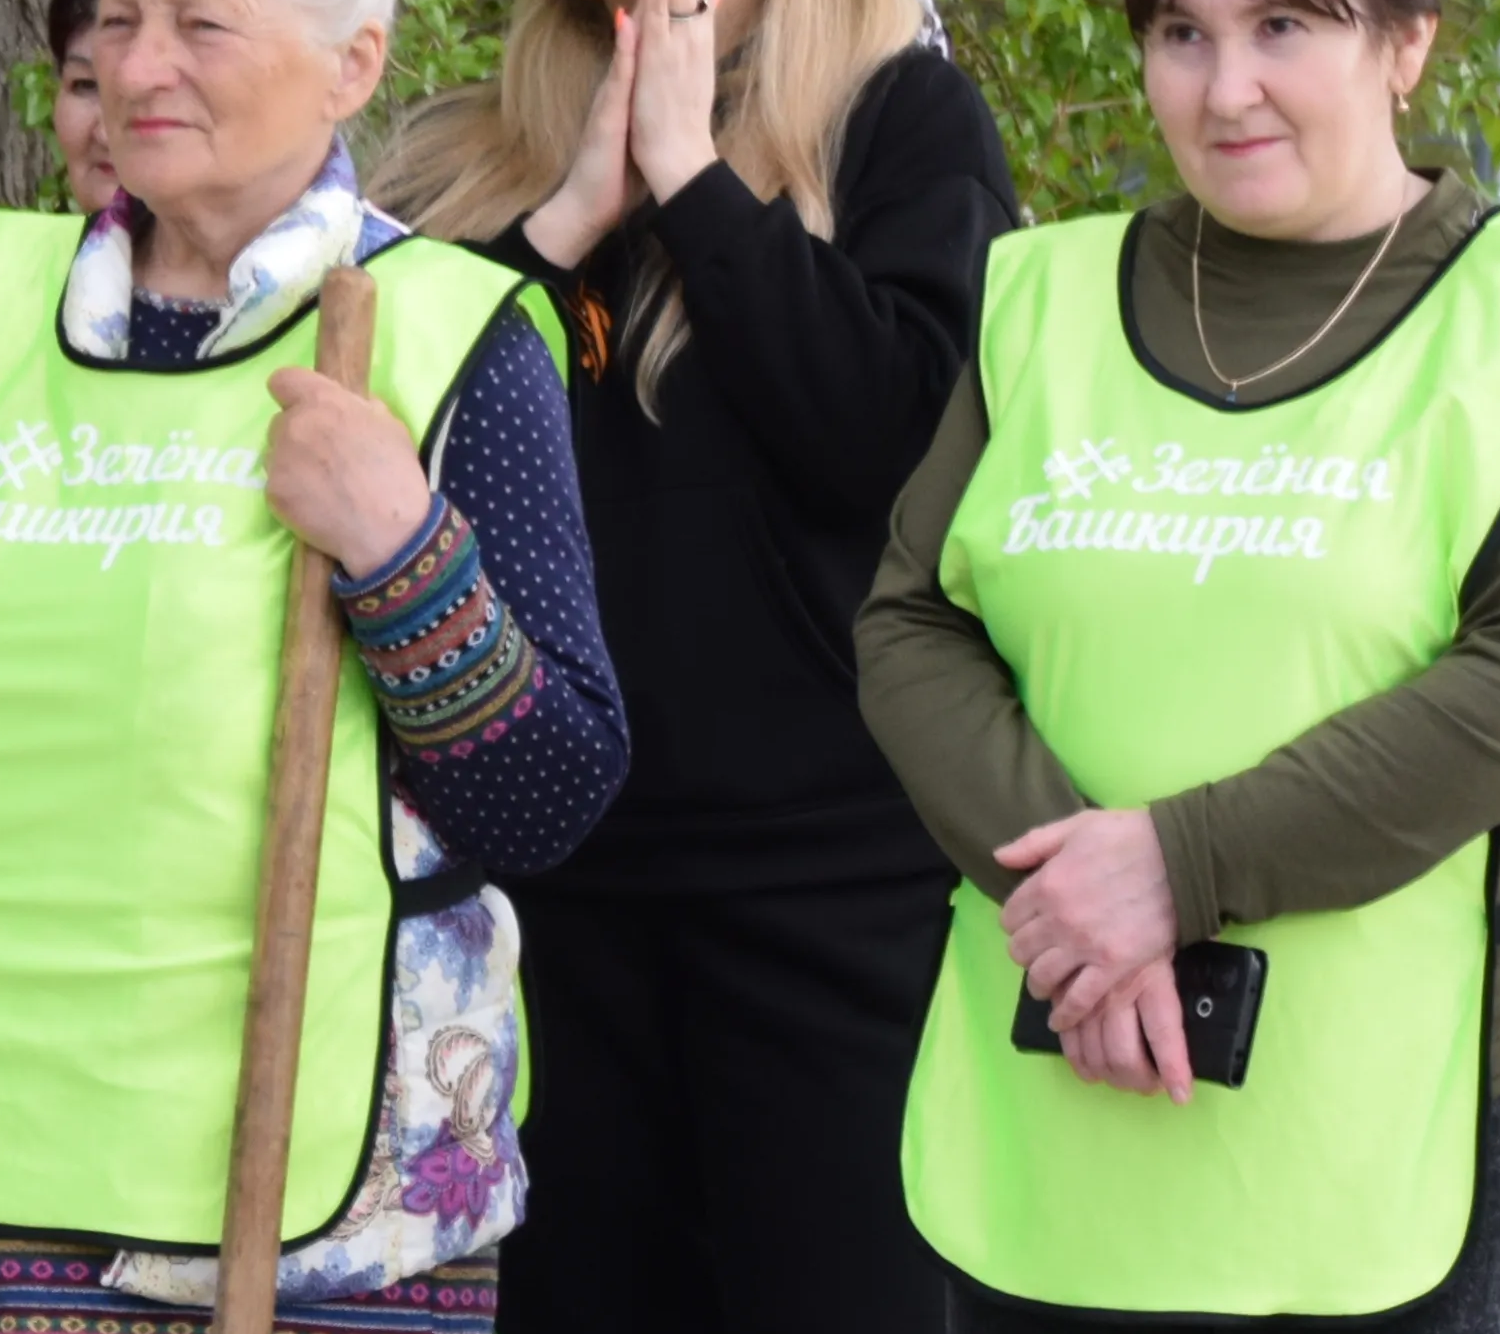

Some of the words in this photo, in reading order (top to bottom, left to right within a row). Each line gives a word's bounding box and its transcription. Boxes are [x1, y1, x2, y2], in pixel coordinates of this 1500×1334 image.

[62, 422, 266, 490] Зелёна
[1131, 441, 1393, 500] Зелёная
[1002, 492, 1328, 585] Башкирия
